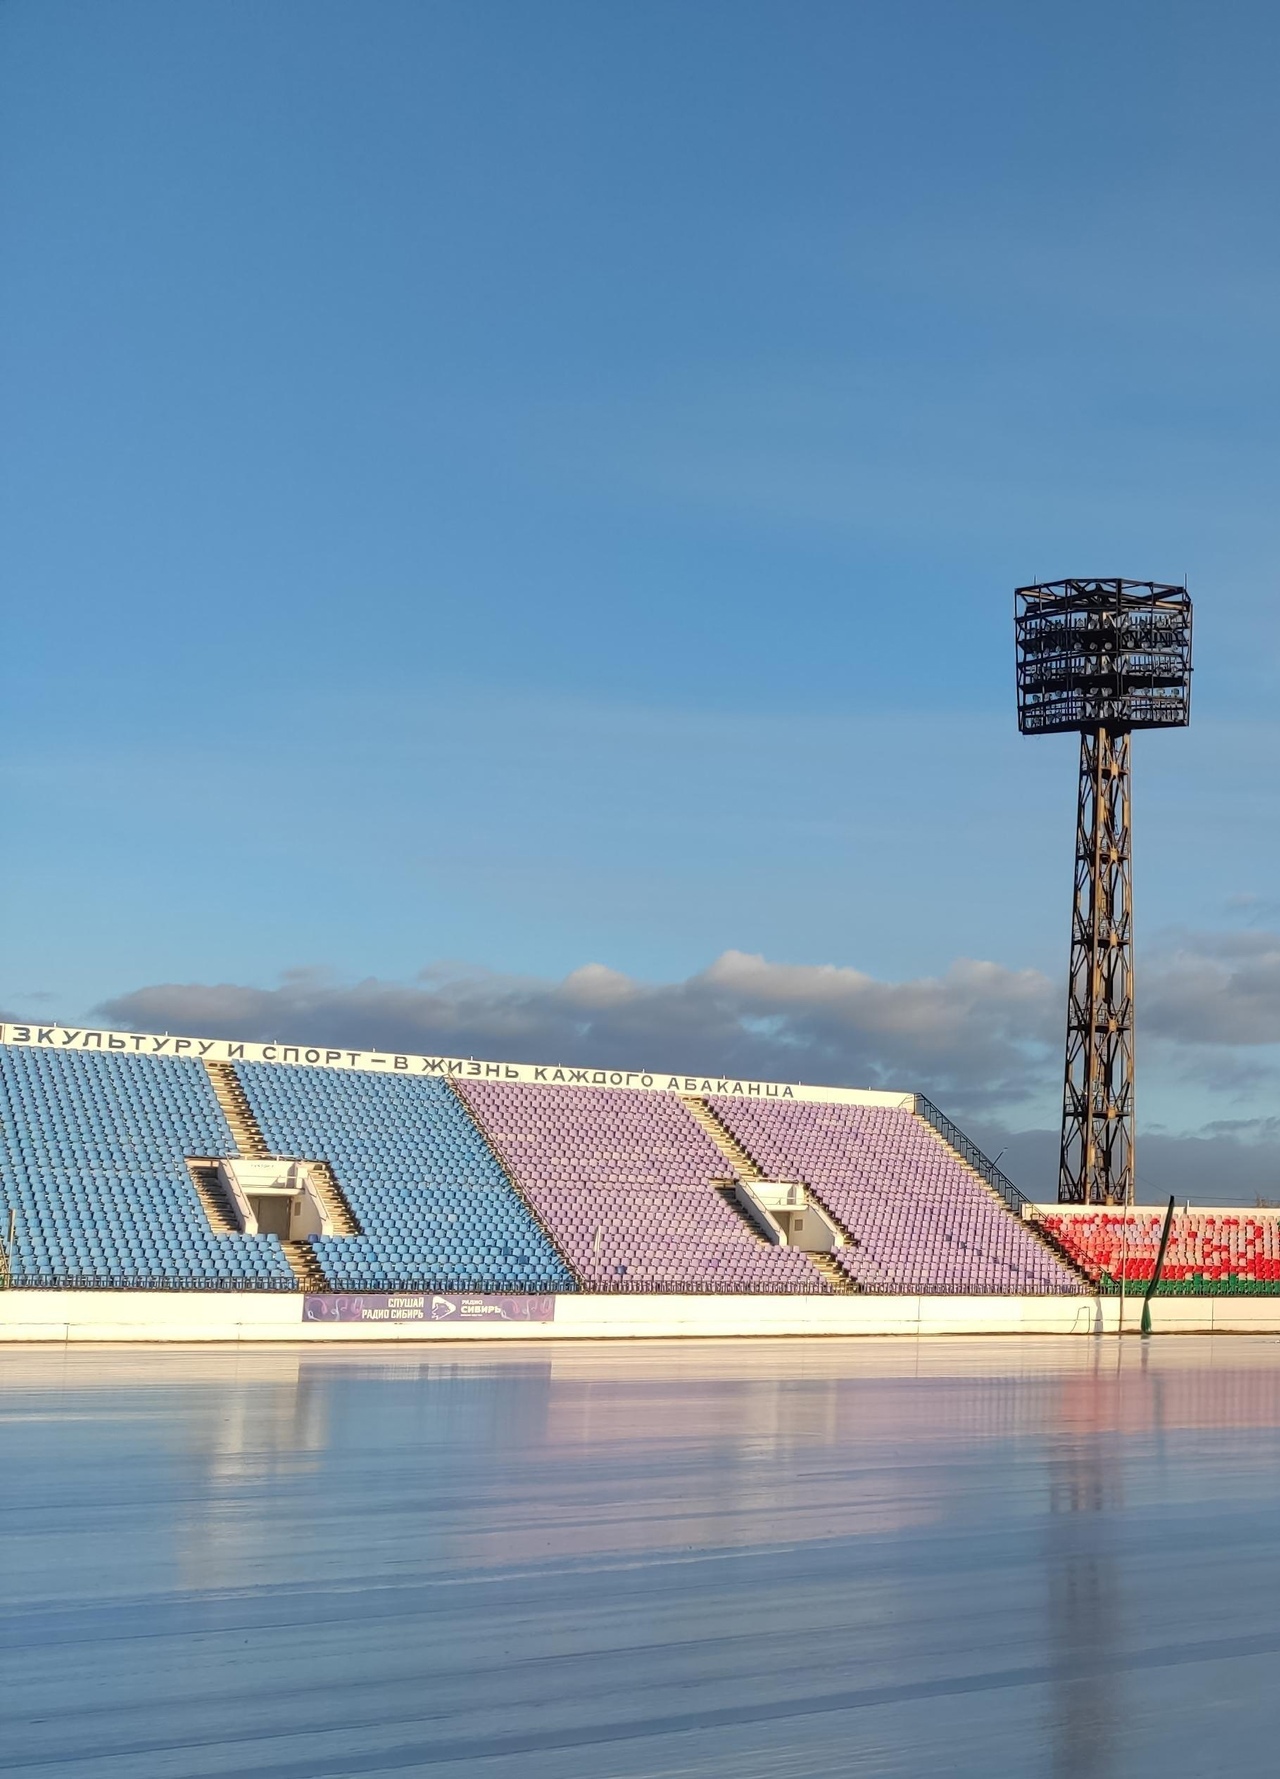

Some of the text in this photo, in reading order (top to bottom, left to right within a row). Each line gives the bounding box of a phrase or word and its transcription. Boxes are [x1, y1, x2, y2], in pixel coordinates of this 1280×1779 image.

[0, 1025, 215, 1056] ЗКУЛЬТУРУ
[228, 1044, 243, 1059] И
[263, 1047, 360, 1067] СПОРТ
[395, 1056, 408, 1070] В
[422, 1059, 519, 1079] ЖИЗНЬ
[534, 1068, 654, 1088] КАЖДОГО
[667, 1078, 794, 1098] АБАКАНЦА
[388, 1297, 424, 1308] СЛУШАЙ
[362, 1309, 424, 1319] РАДИО СИБИРЬ
[460, 1305, 502, 1314] СИБИРЬ
